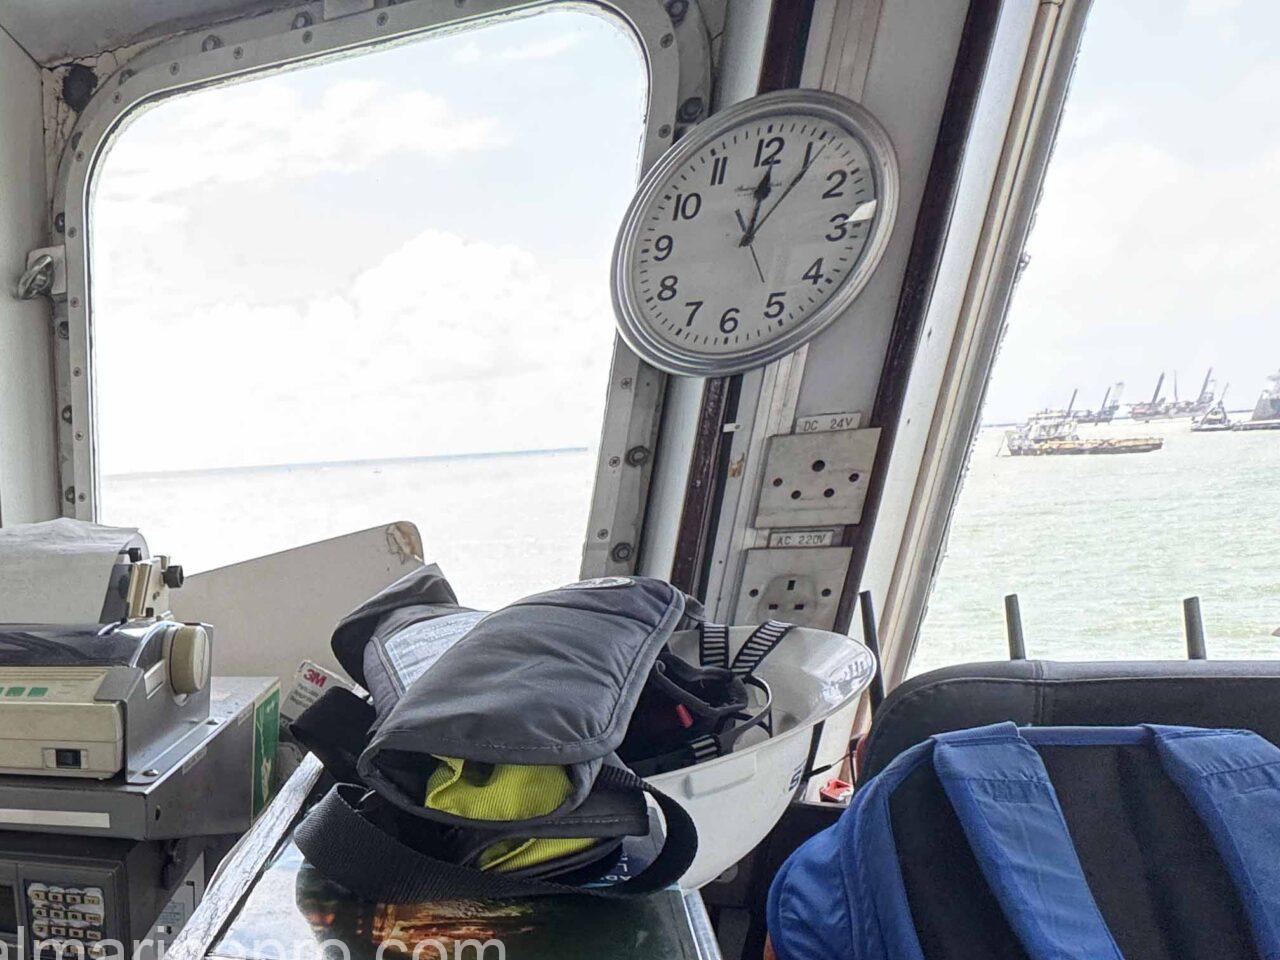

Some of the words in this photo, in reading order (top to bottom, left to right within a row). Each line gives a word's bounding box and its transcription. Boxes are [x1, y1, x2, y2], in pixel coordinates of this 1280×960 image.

[754, 137, 784, 167] 12
[803, 141, 813, 168] 1
[710, 157, 727, 185] 11
[822, 170, 847, 199] 2
[673, 193, 702, 221] 10
[825, 213, 849, 242] 3
[653, 235, 673, 261] 9
[802, 258, 824, 285] 4
[657, 275, 678, 301] 8
[685, 301, 703, 327] 7
[763, 292, 786, 318] 5
[720, 308, 740, 334] 6
[803, 420, 818, 432] DC
[830, 417, 854, 429] 24V
[798, 533, 826, 545] 220V
[303, 668, 328, 688] 3M
